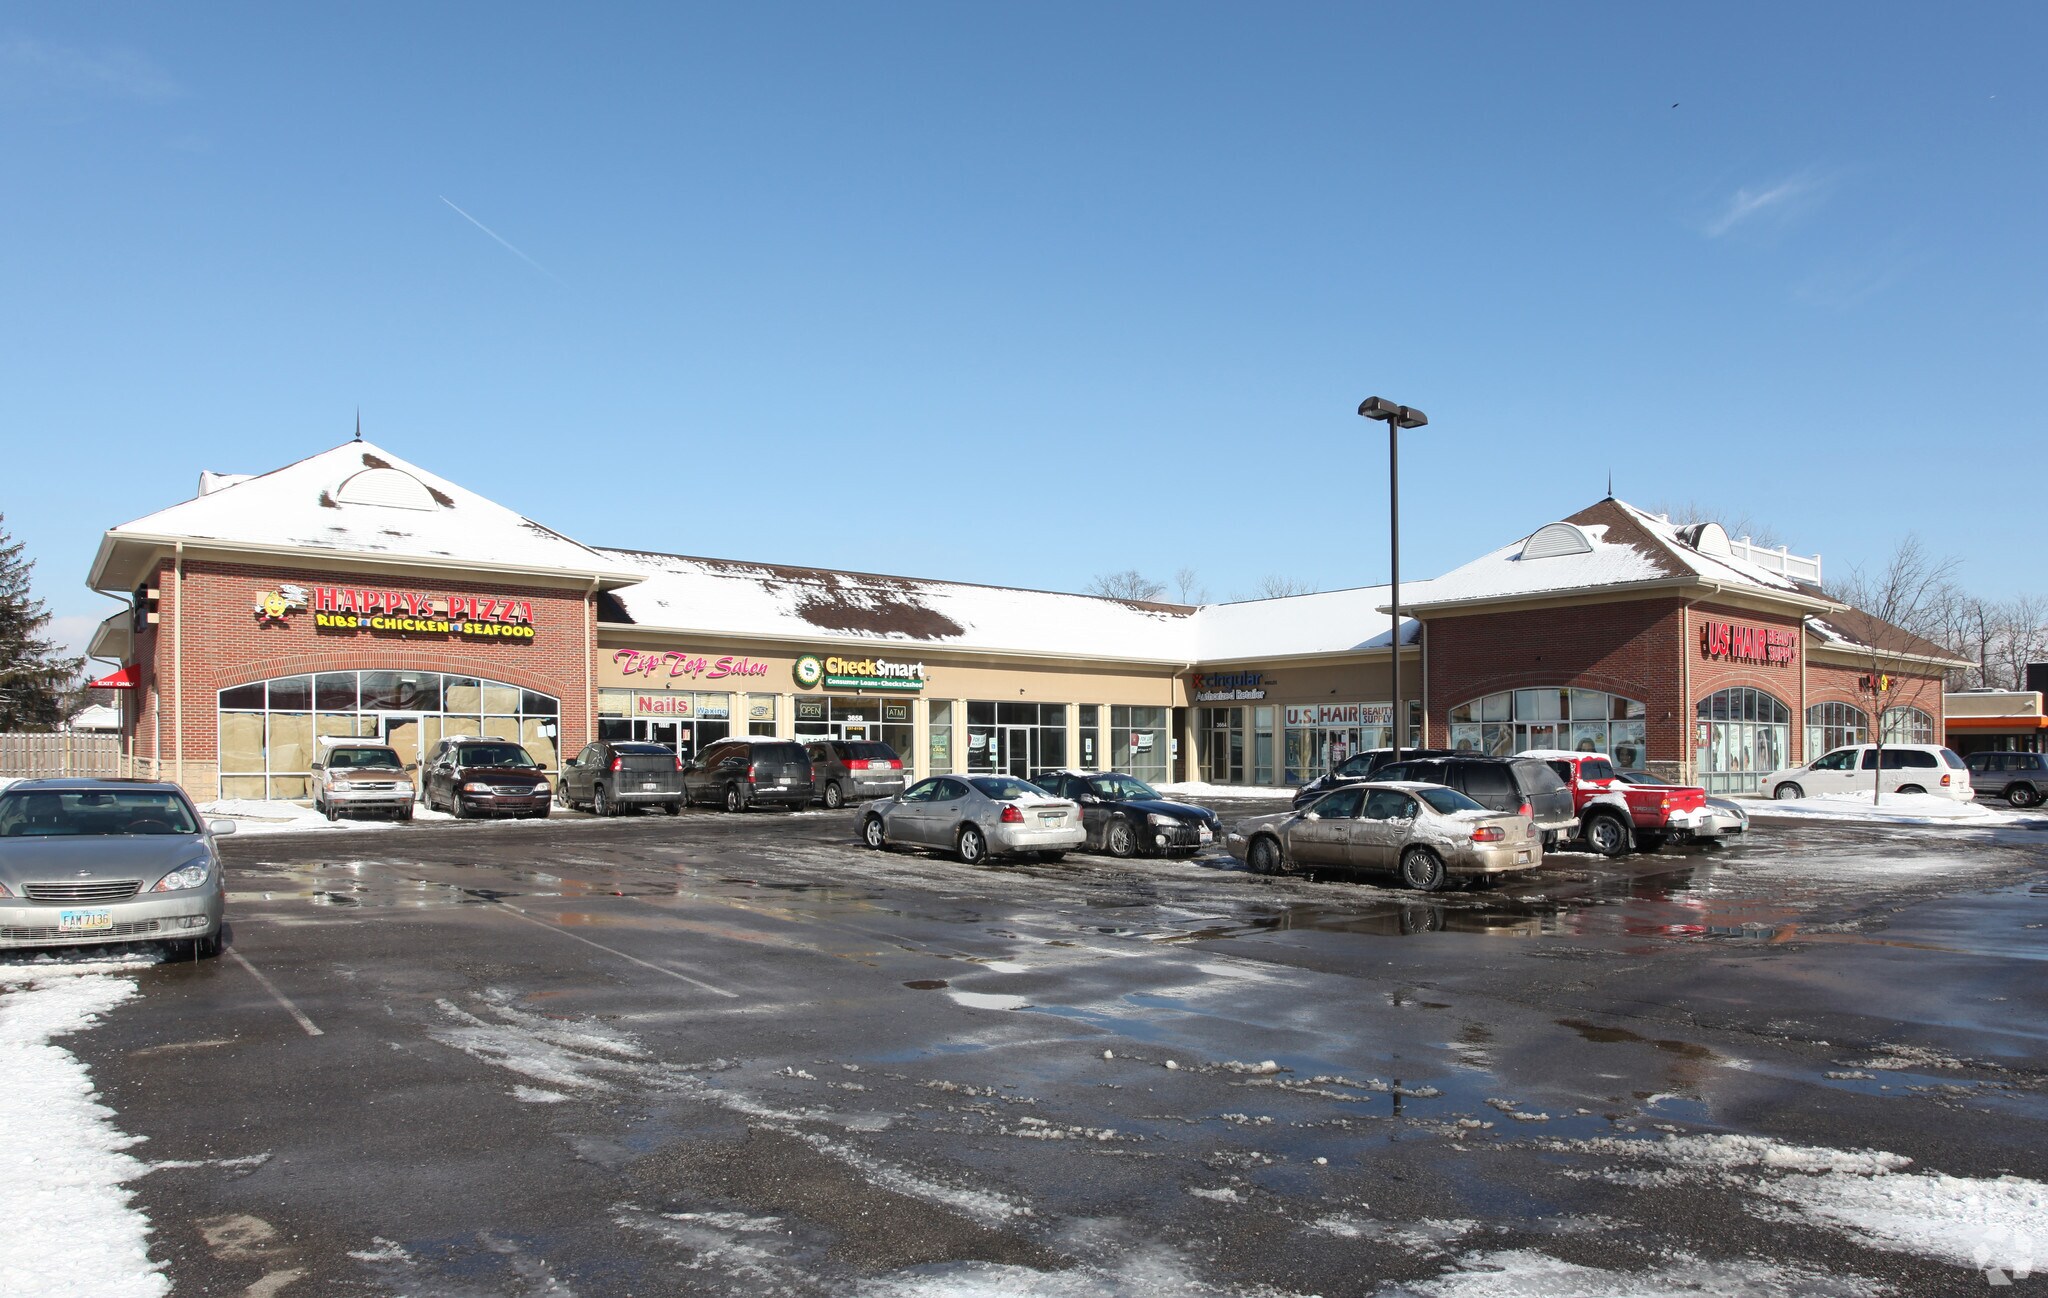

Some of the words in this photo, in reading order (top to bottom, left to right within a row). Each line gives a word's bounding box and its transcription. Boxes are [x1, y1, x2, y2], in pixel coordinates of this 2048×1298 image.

[447, 596, 534, 623] PIZZA
[316, 614, 357, 628] RIBS
[371, 617, 449, 633] CHICKEN
[463, 623, 535, 637] SEAFOOD
[1708, 622, 1729, 655] US
[1732, 625, 1767, 660] HAIR
[1767, 629, 1797, 646] BEAUTY
[1768, 645, 1797, 662] SUPPLY
[613, 649, 660, 677] Tip
[661, 650, 707, 679] Top
[706, 656, 769, 678] Salon
[827, 678, 859, 686] Consumer
[1206, 670, 1263, 690] cingular
[1196, 690, 1235, 701] Authorized
[1236, 688, 1265, 700] Retailer
[638, 696, 689, 714] Nails
[696, 706, 728, 717] Waxing
[801, 706, 821, 715] OPEN
[889, 708, 903, 716] ATM
[1362, 706, 1393, 716] BEAUTY
[1287, 708, 1316, 724] U.S.
[1320, 706, 1358, 722] HAIR
[1363, 715, 1392, 724] SUPPLY
[63, 914, 82, 927] FAM
[85, 913, 110, 925] 7136
